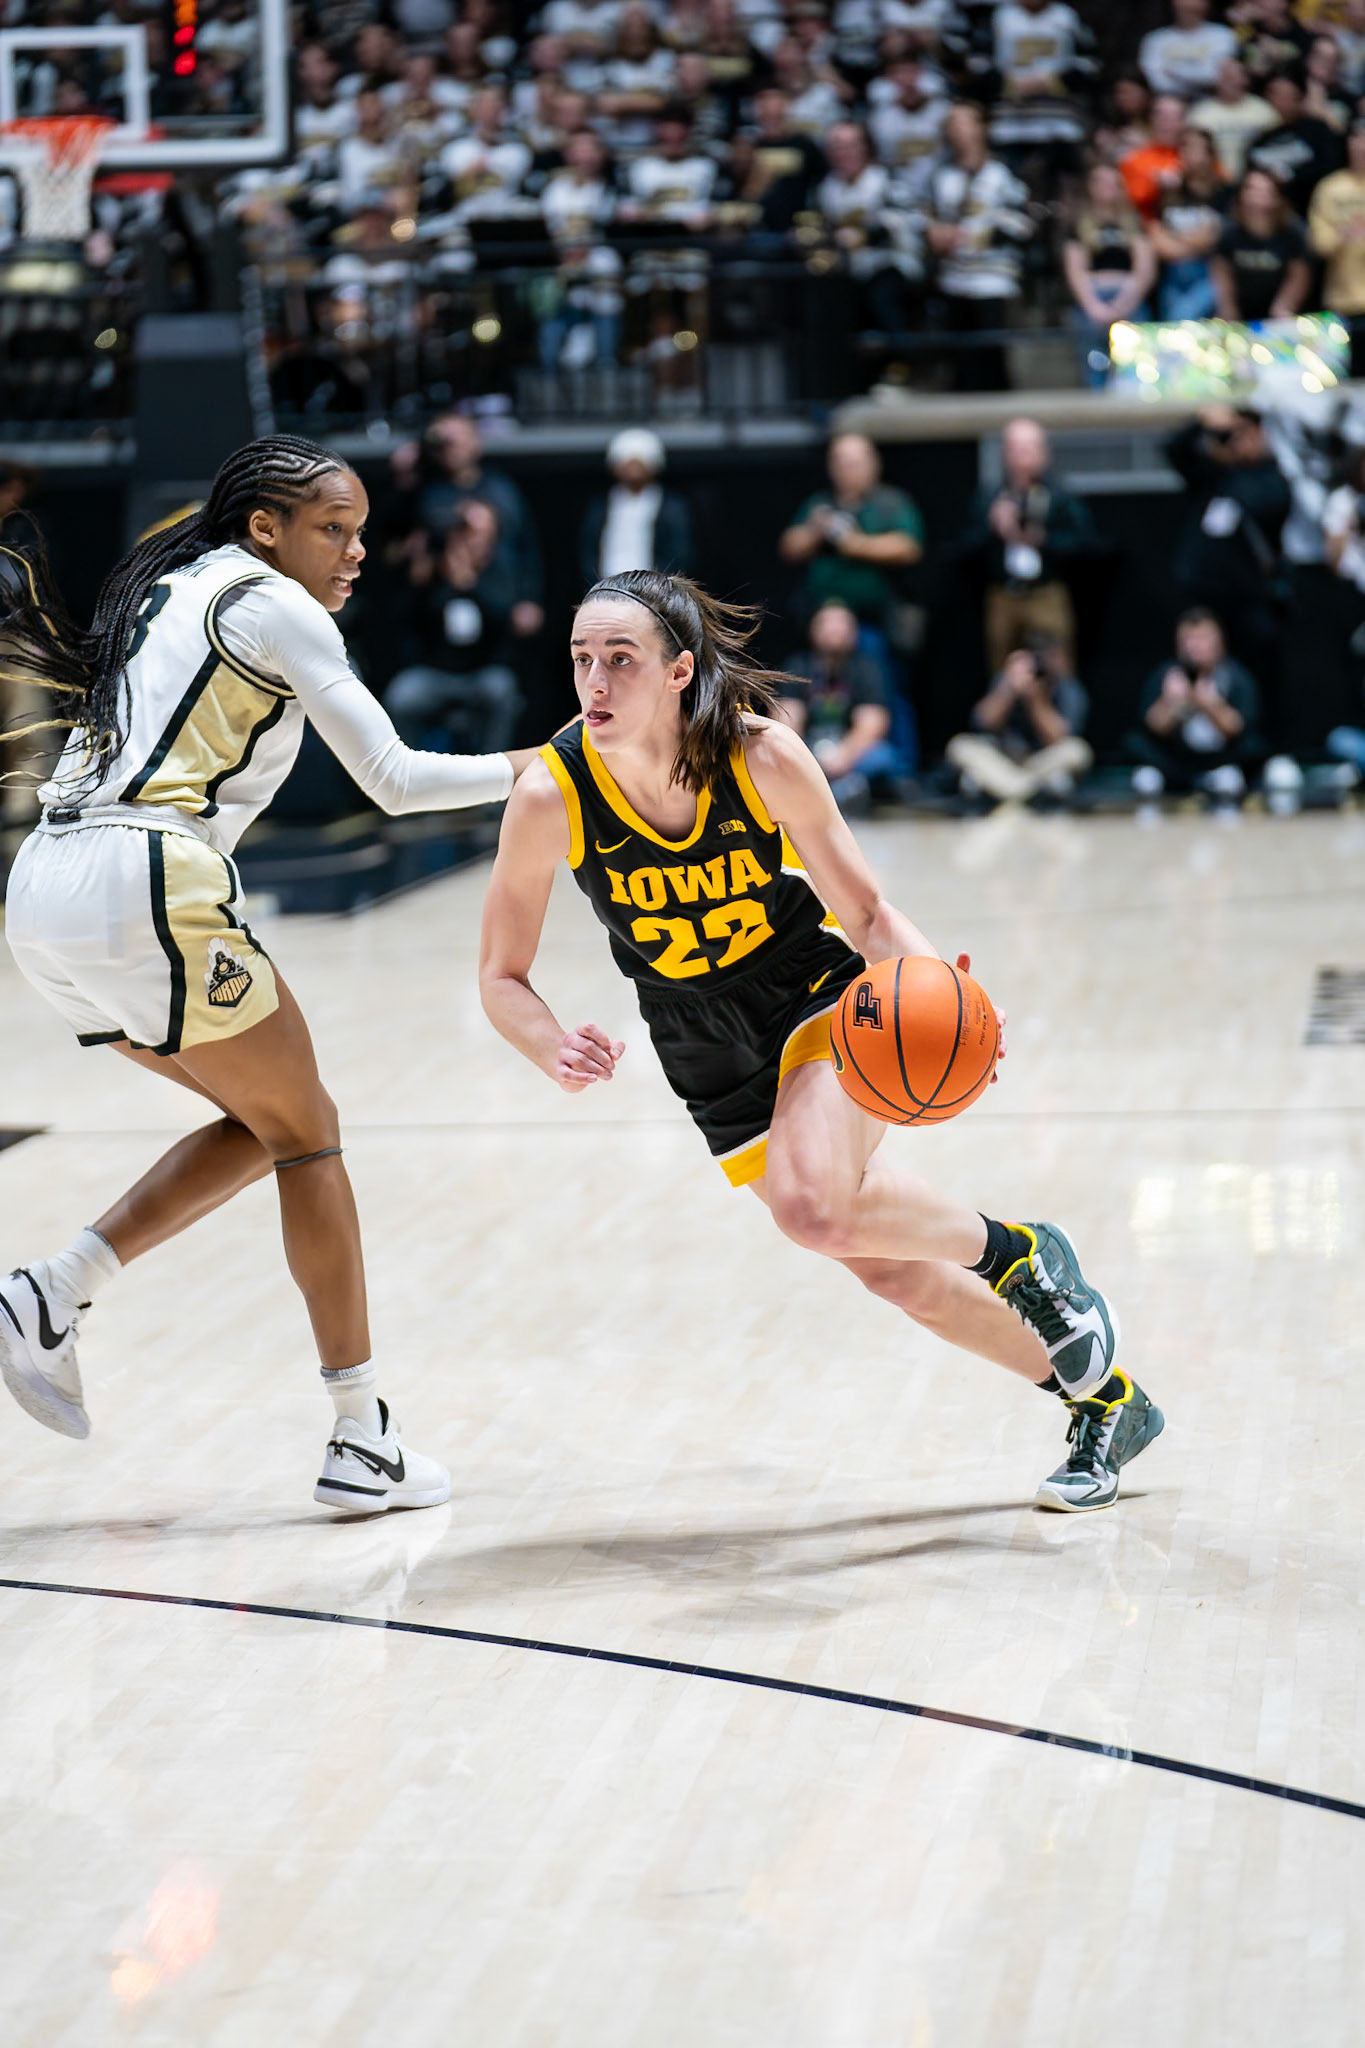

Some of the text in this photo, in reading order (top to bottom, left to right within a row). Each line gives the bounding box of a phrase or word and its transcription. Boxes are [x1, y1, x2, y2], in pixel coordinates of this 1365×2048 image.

[605, 849, 773, 911] IOWA
[630, 899, 776, 979] 22
[210, 972, 251, 1002] PURDUE
[853, 982, 883, 1030] P
